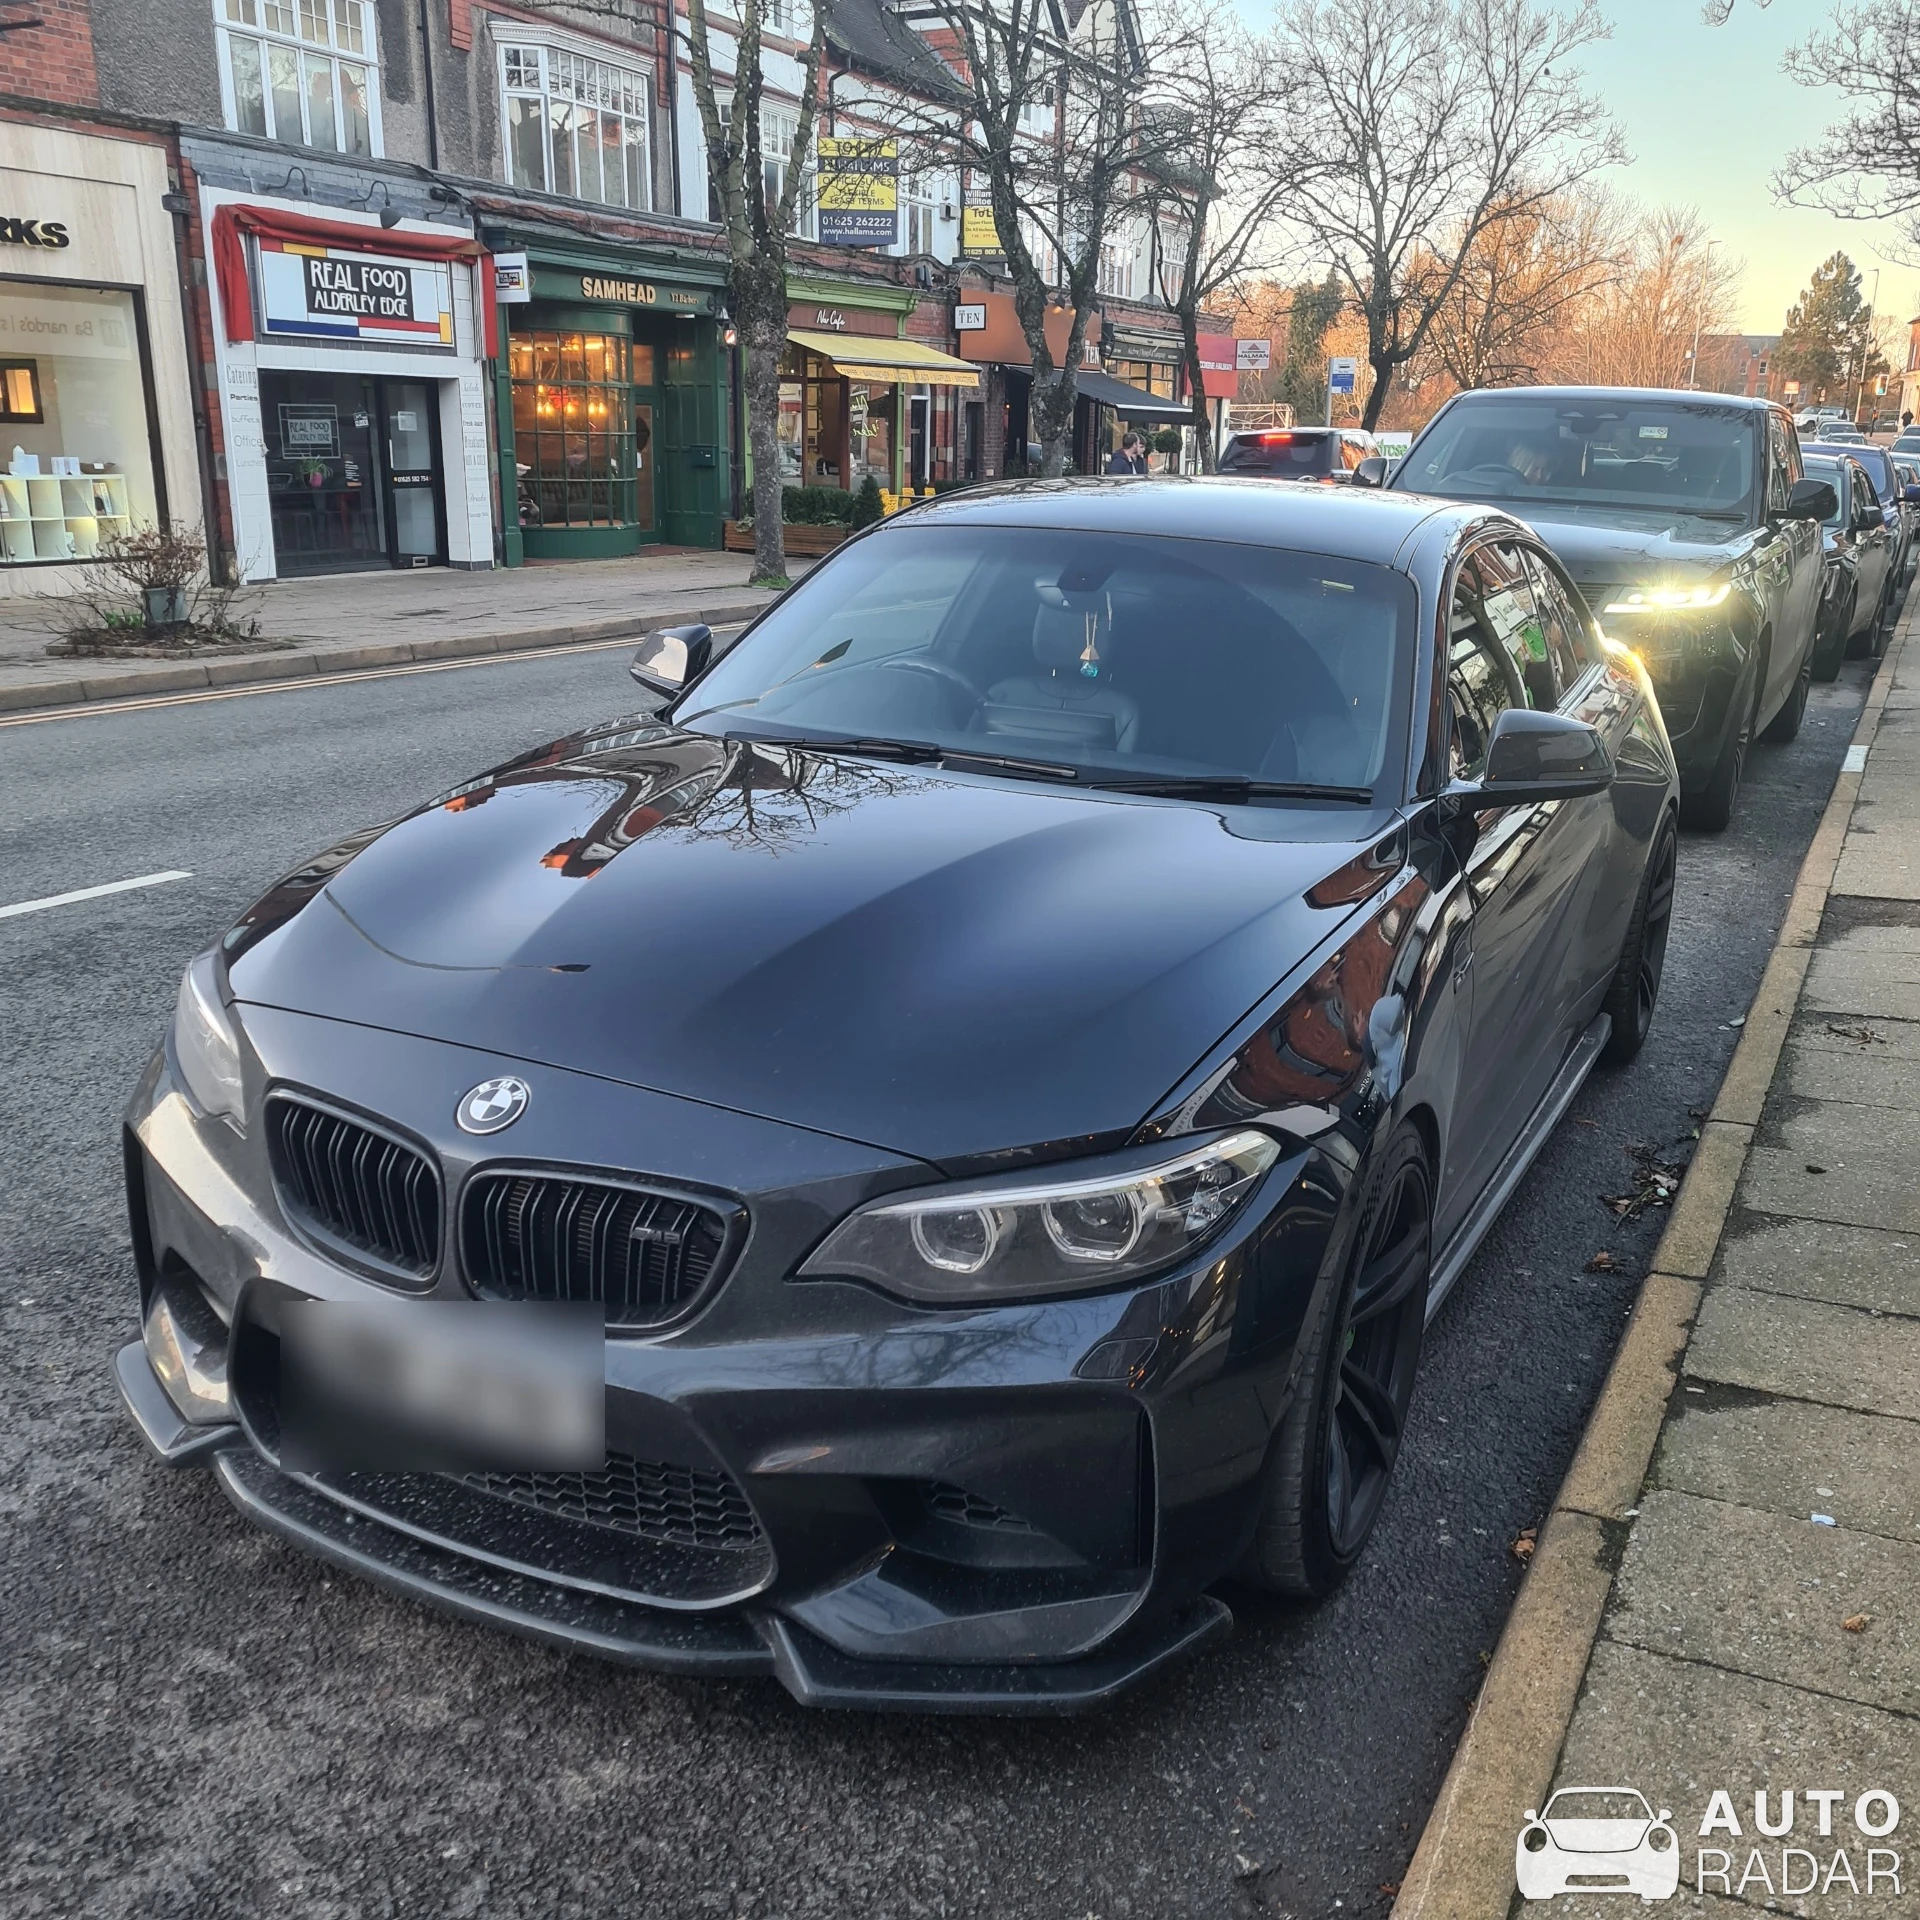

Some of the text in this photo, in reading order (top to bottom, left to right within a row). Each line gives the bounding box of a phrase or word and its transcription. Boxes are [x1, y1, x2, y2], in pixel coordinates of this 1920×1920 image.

[822, 216, 892, 227] 01625 262222
[822, 227, 893, 237] www.hallams.com
[310, 260, 407, 297] REAL FOOD
[582, 276, 657, 304] SAMHEAD
[314, 289, 408, 317] ALDERLEY EDGE
[959, 312, 980, 324] TEN
[1084, 345, 1100, 365] TEN
[226, 365, 257, 388] Catering
[230, 393, 259, 402] Parties
[289, 421, 330, 433] REAL FOOD
[233, 434, 263, 448] Office
[479, 1079, 524, 1101] BMW
